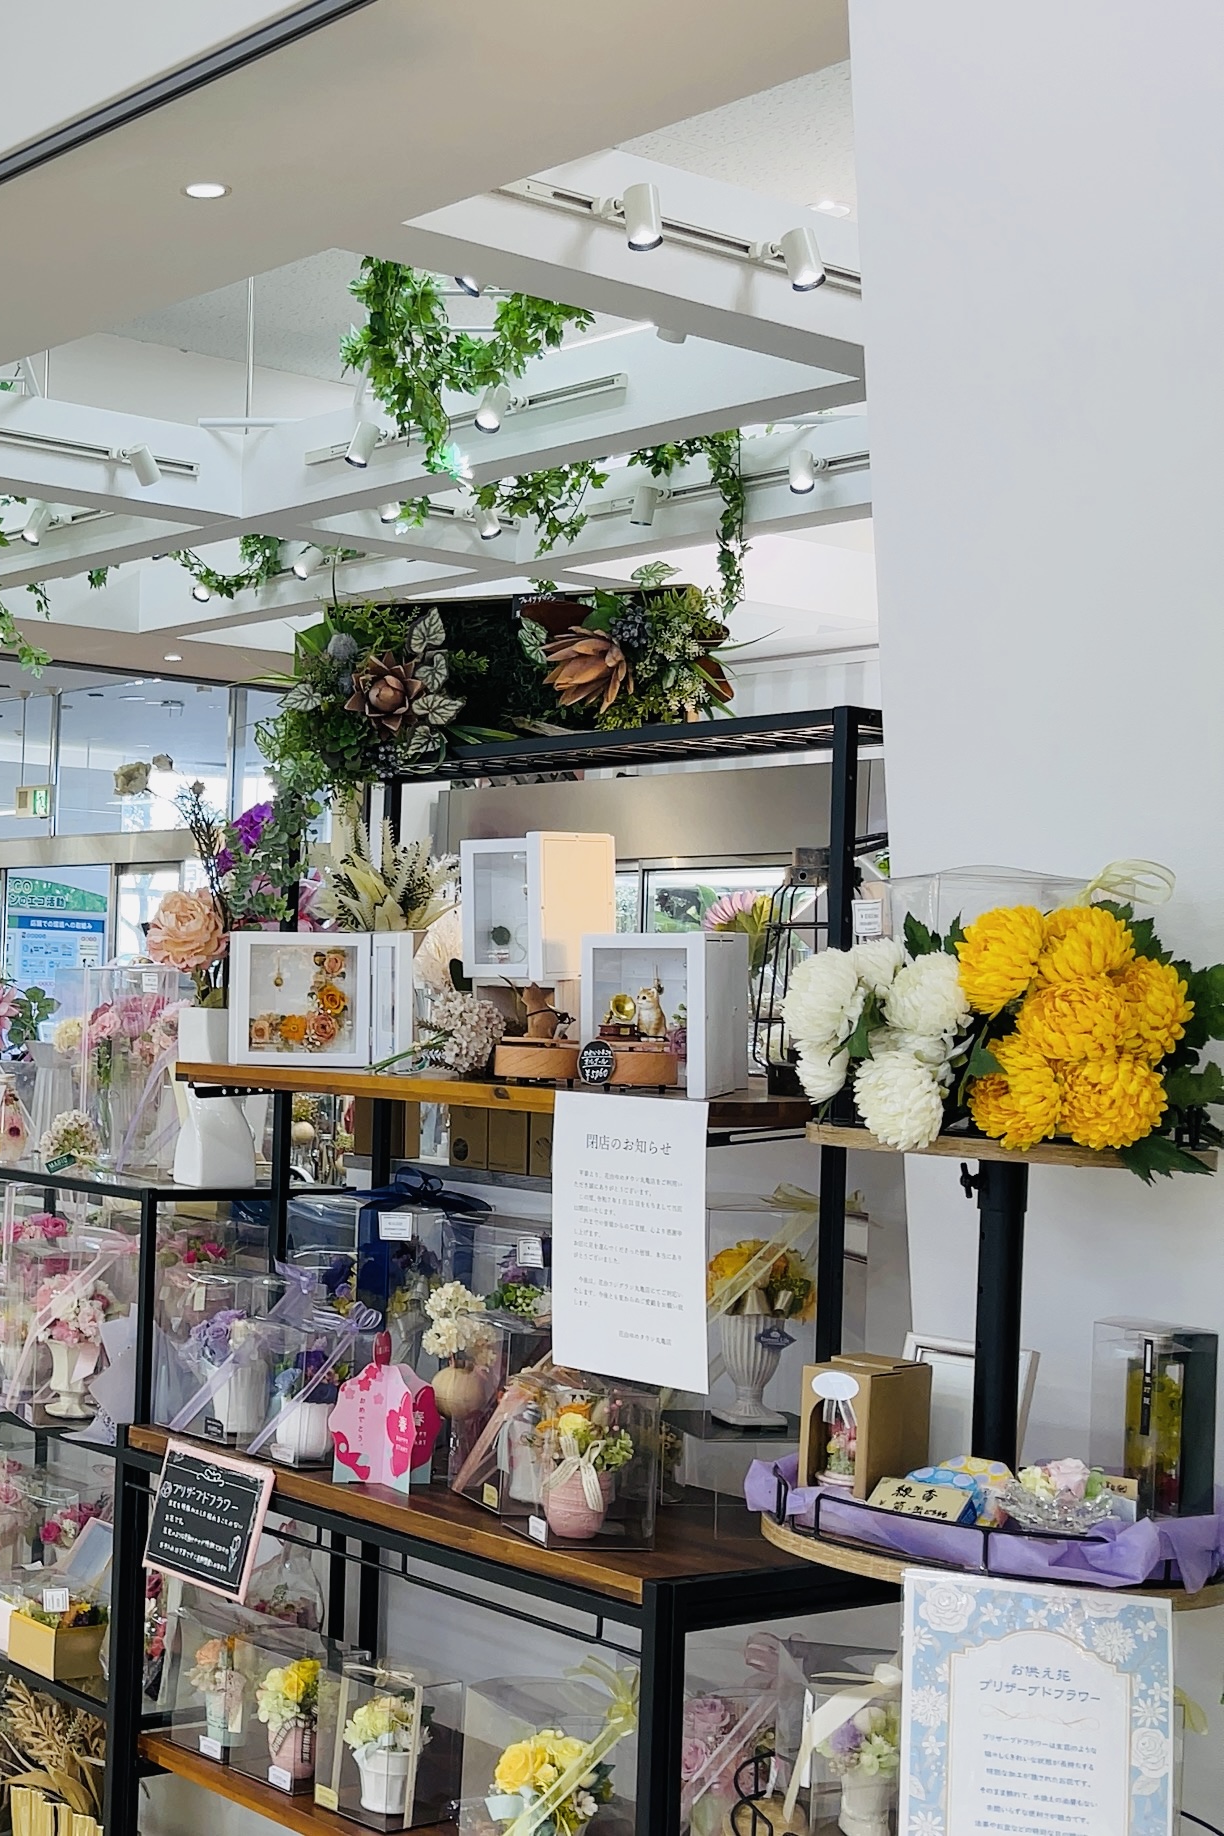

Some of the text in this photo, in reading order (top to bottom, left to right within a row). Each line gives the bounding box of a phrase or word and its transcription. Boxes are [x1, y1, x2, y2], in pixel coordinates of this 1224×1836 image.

[585, 1133, 672, 1156] 閉店のお知らせ
[397, 1415, 409, 1433] 春
[979, 1678, 1101, 1702] プリザーブドフラワー
